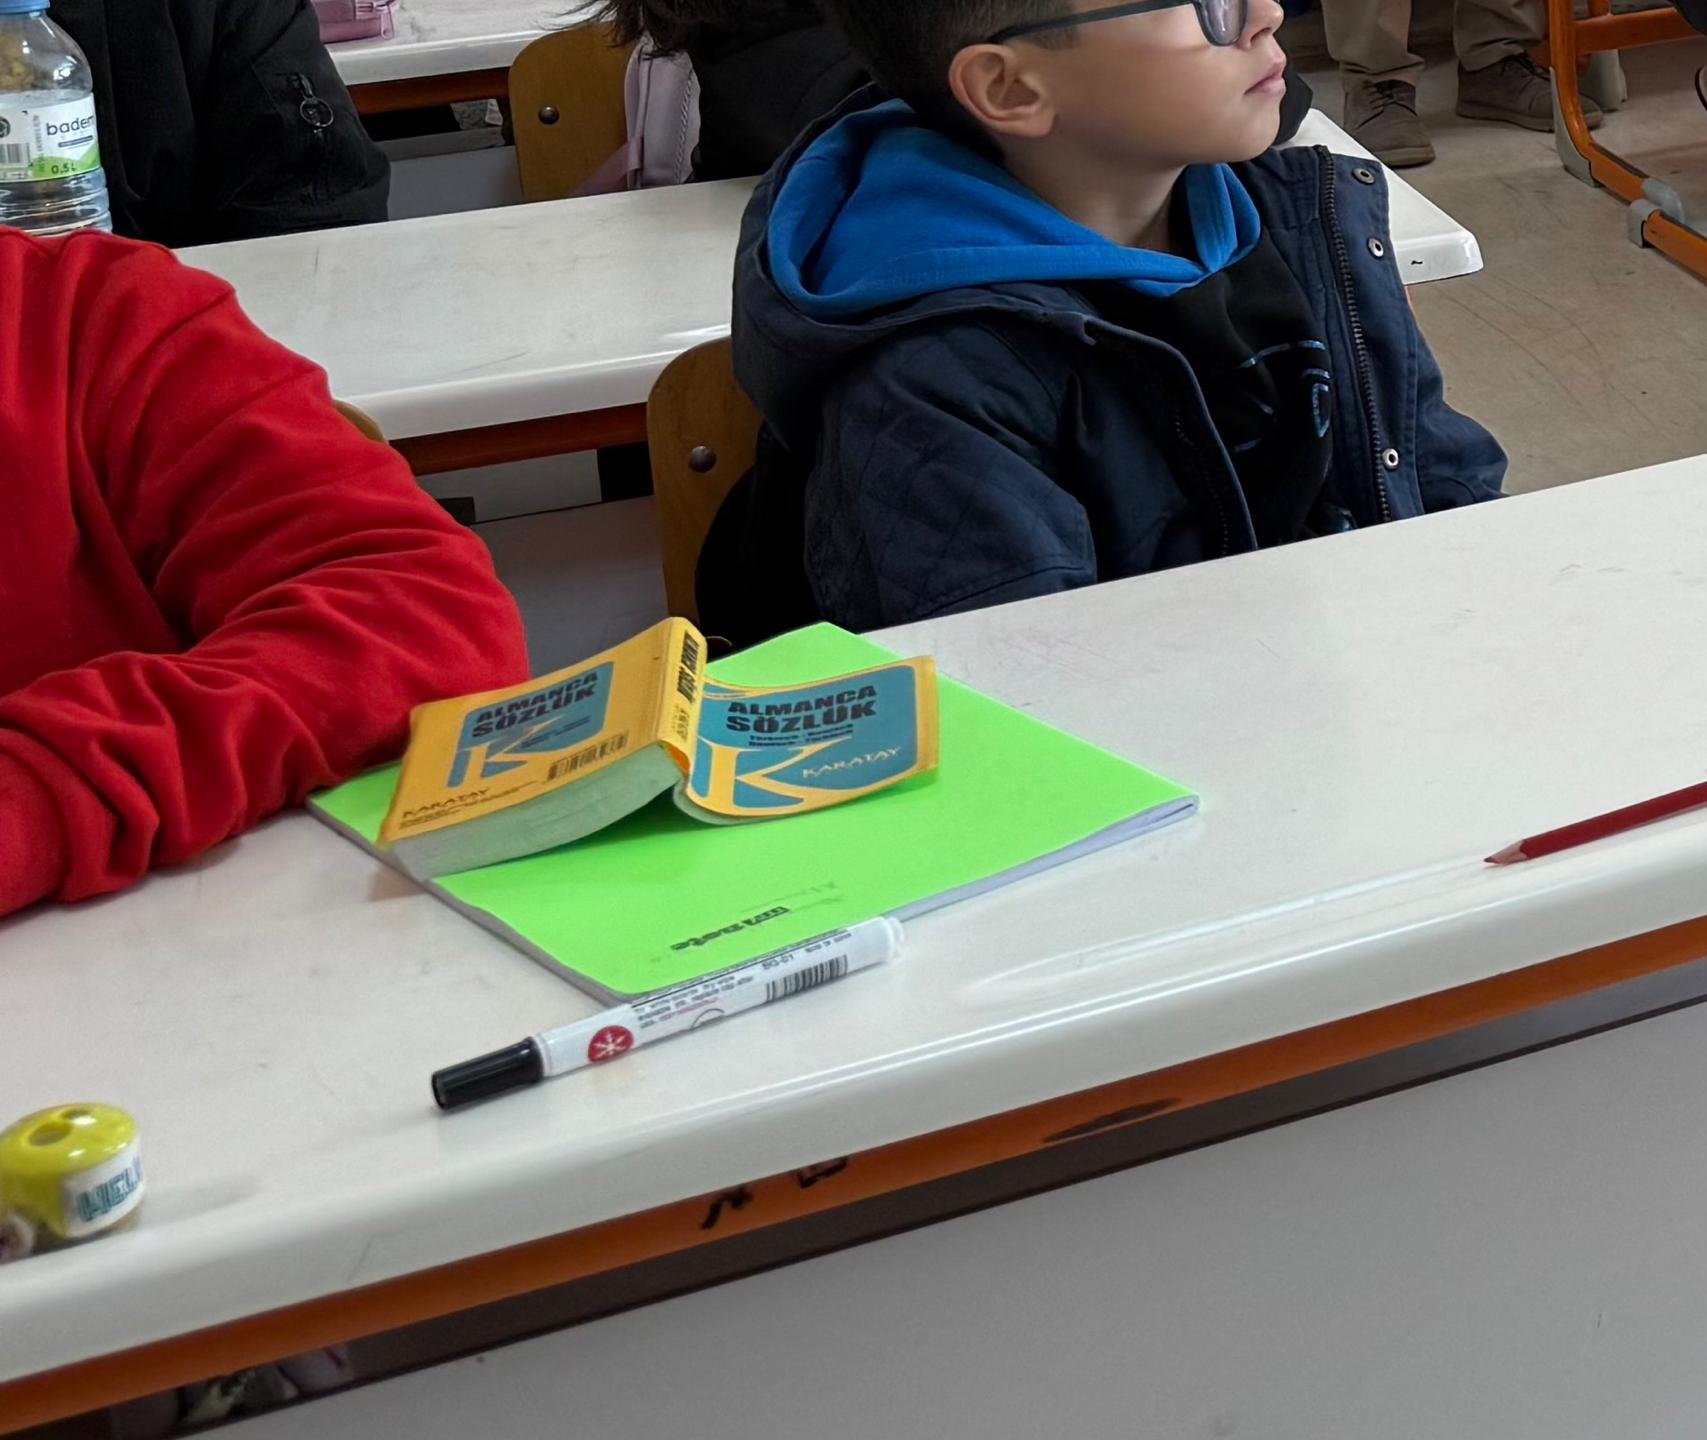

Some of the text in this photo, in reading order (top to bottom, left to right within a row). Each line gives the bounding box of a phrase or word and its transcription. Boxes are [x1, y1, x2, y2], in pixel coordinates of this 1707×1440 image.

[471, 683, 597, 739] SÖZLÜK
[476, 670, 599, 725] ALMANCA
[727, 684, 878, 716] ALMANCA
[726, 700, 877, 734] SÖZLÜK
[801, 746, 902, 779] KARATAY
